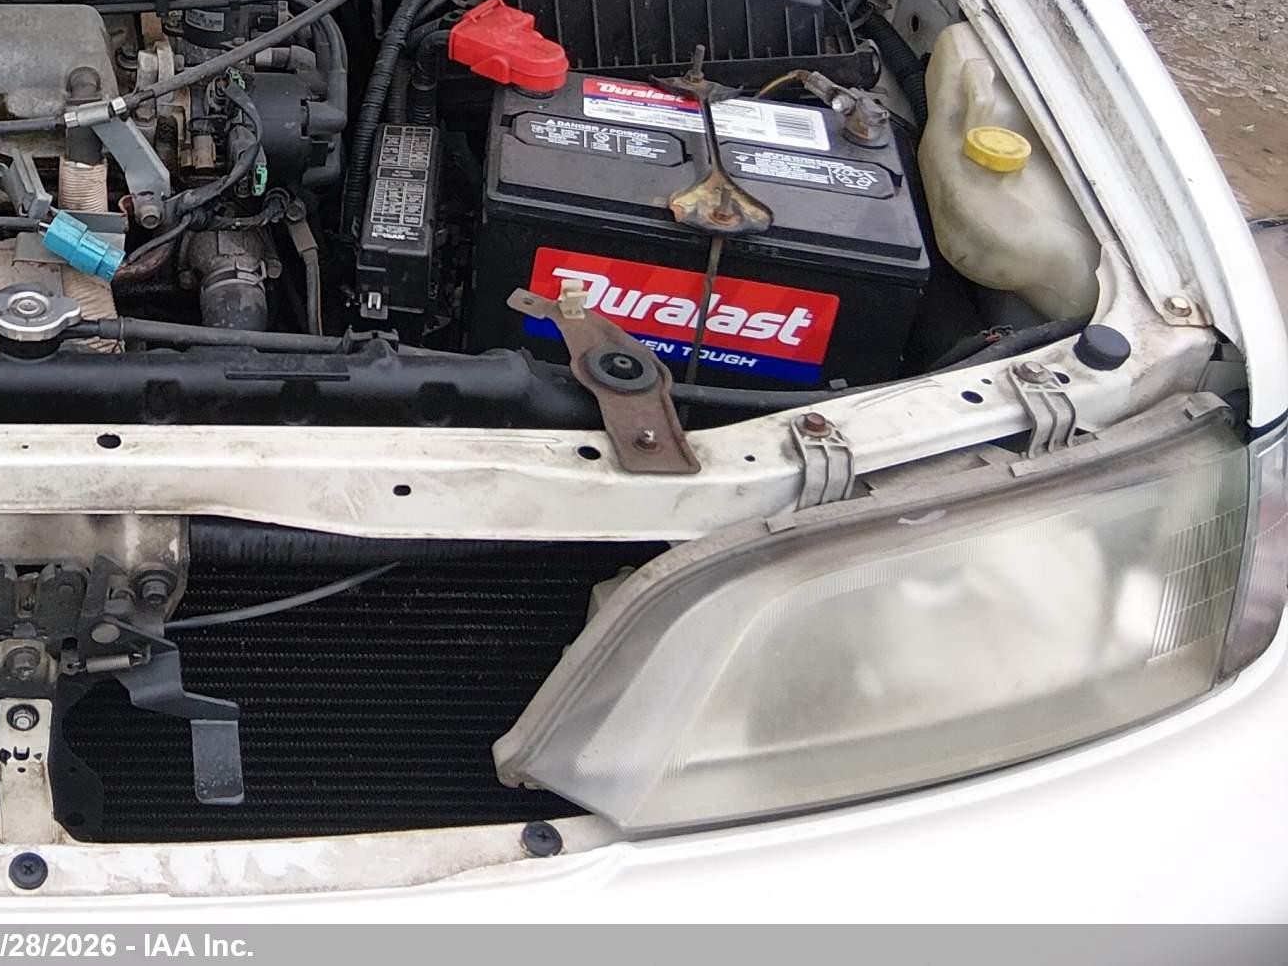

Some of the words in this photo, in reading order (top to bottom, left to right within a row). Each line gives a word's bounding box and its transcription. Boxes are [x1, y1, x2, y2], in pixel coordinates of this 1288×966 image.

[597, 82, 685, 103] Duralast
[557, 120, 601, 134] DANGER
[609, 128, 649, 140] POISON
[552, 267, 813, 346] Duralast
